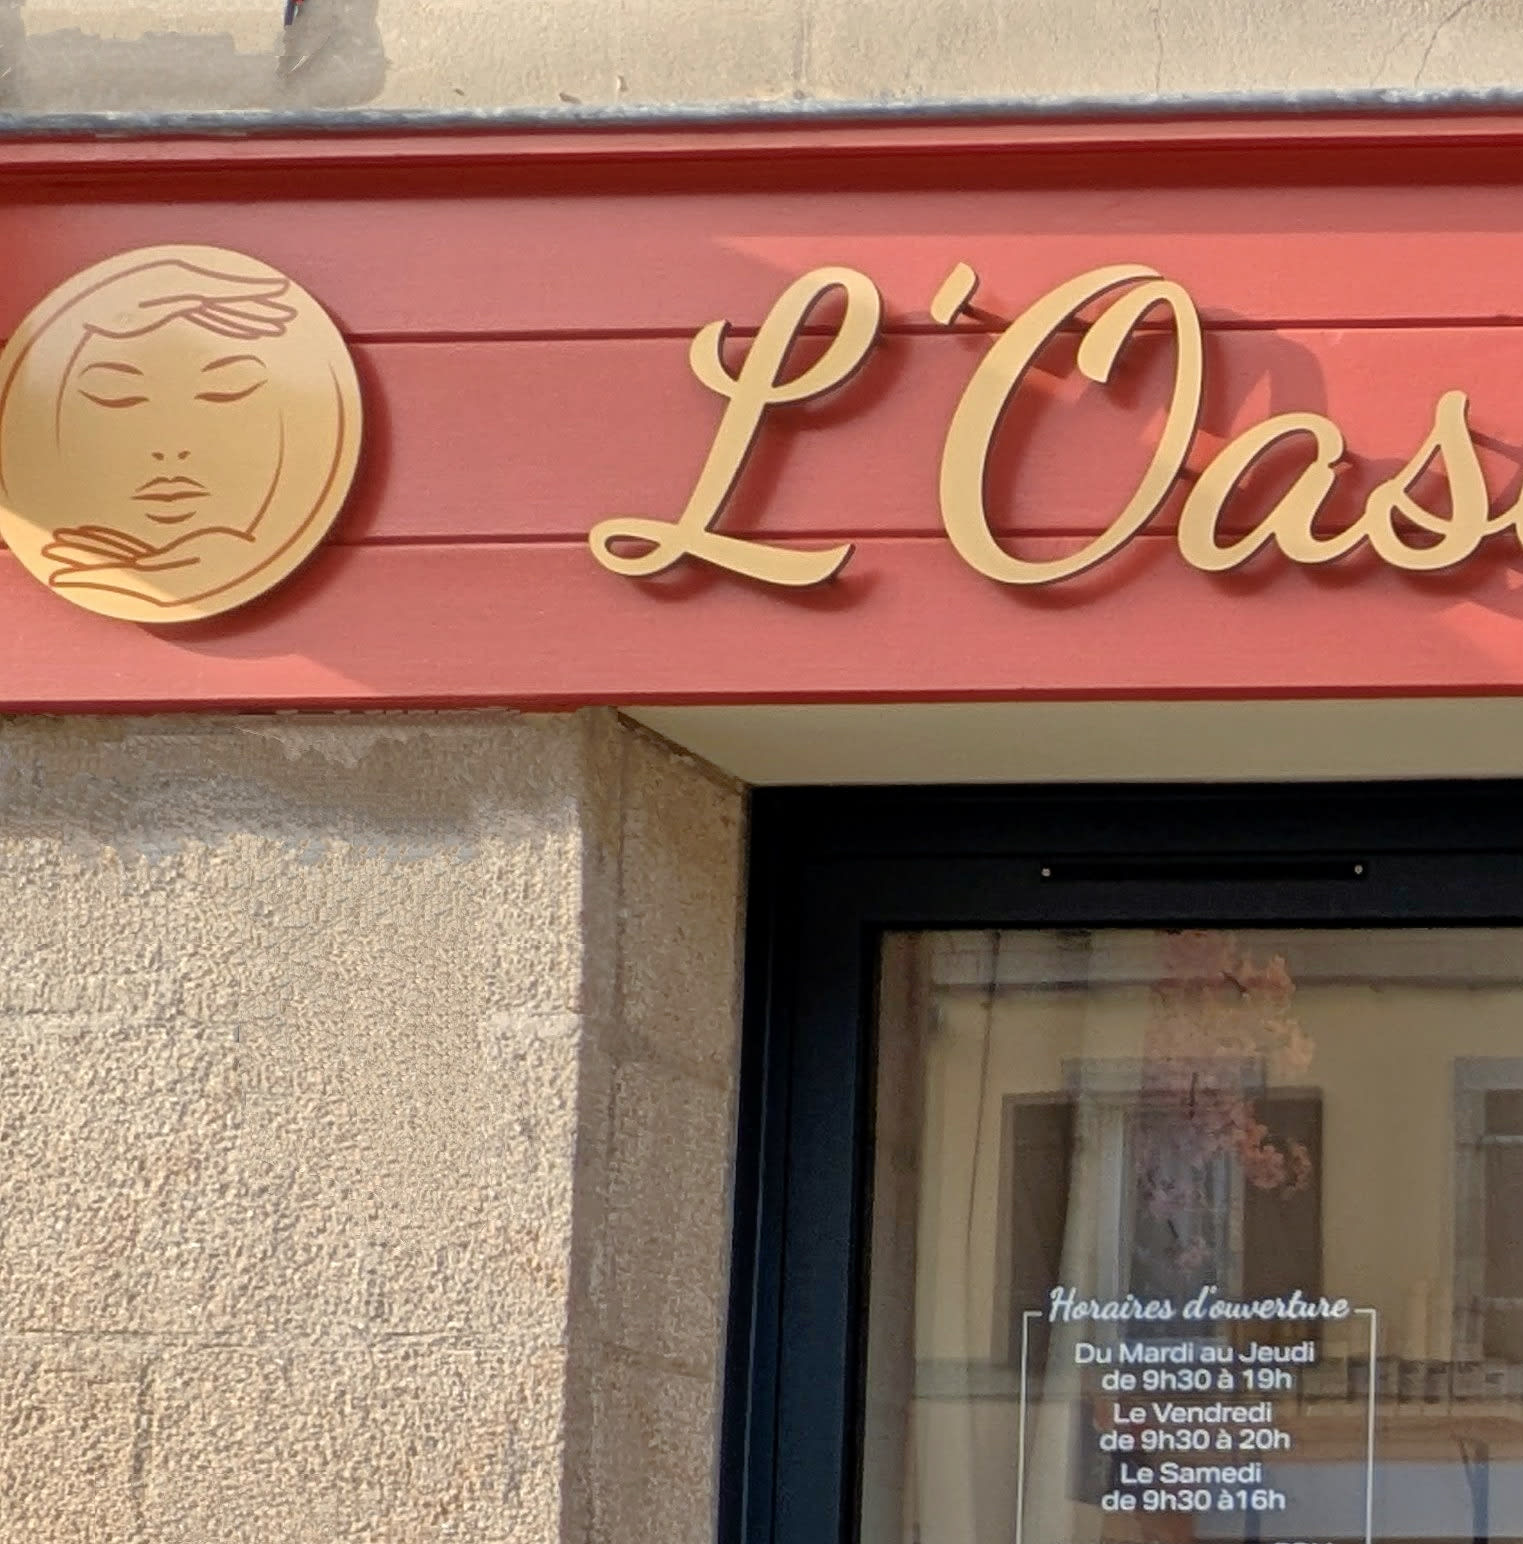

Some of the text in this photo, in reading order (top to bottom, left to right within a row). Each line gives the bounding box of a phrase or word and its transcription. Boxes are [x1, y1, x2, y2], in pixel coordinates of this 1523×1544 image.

[1048, 1284, 1350, 1322] Horaires d'ouverture
[1074, 1342, 1315, 1363] Du Mardi au Jeudi
[1102, 1369, 1292, 1391] de 9h30 à 19h
[1114, 1403, 1272, 1423] Le Vendredi
[1100, 1428, 1291, 1450] de 9h30 à 20h
[1121, 1462, 1262, 1484] Le Samedi
[1102, 1490, 1136, 1510] de
[1142, 1490, 1212, 1510] 9h30
